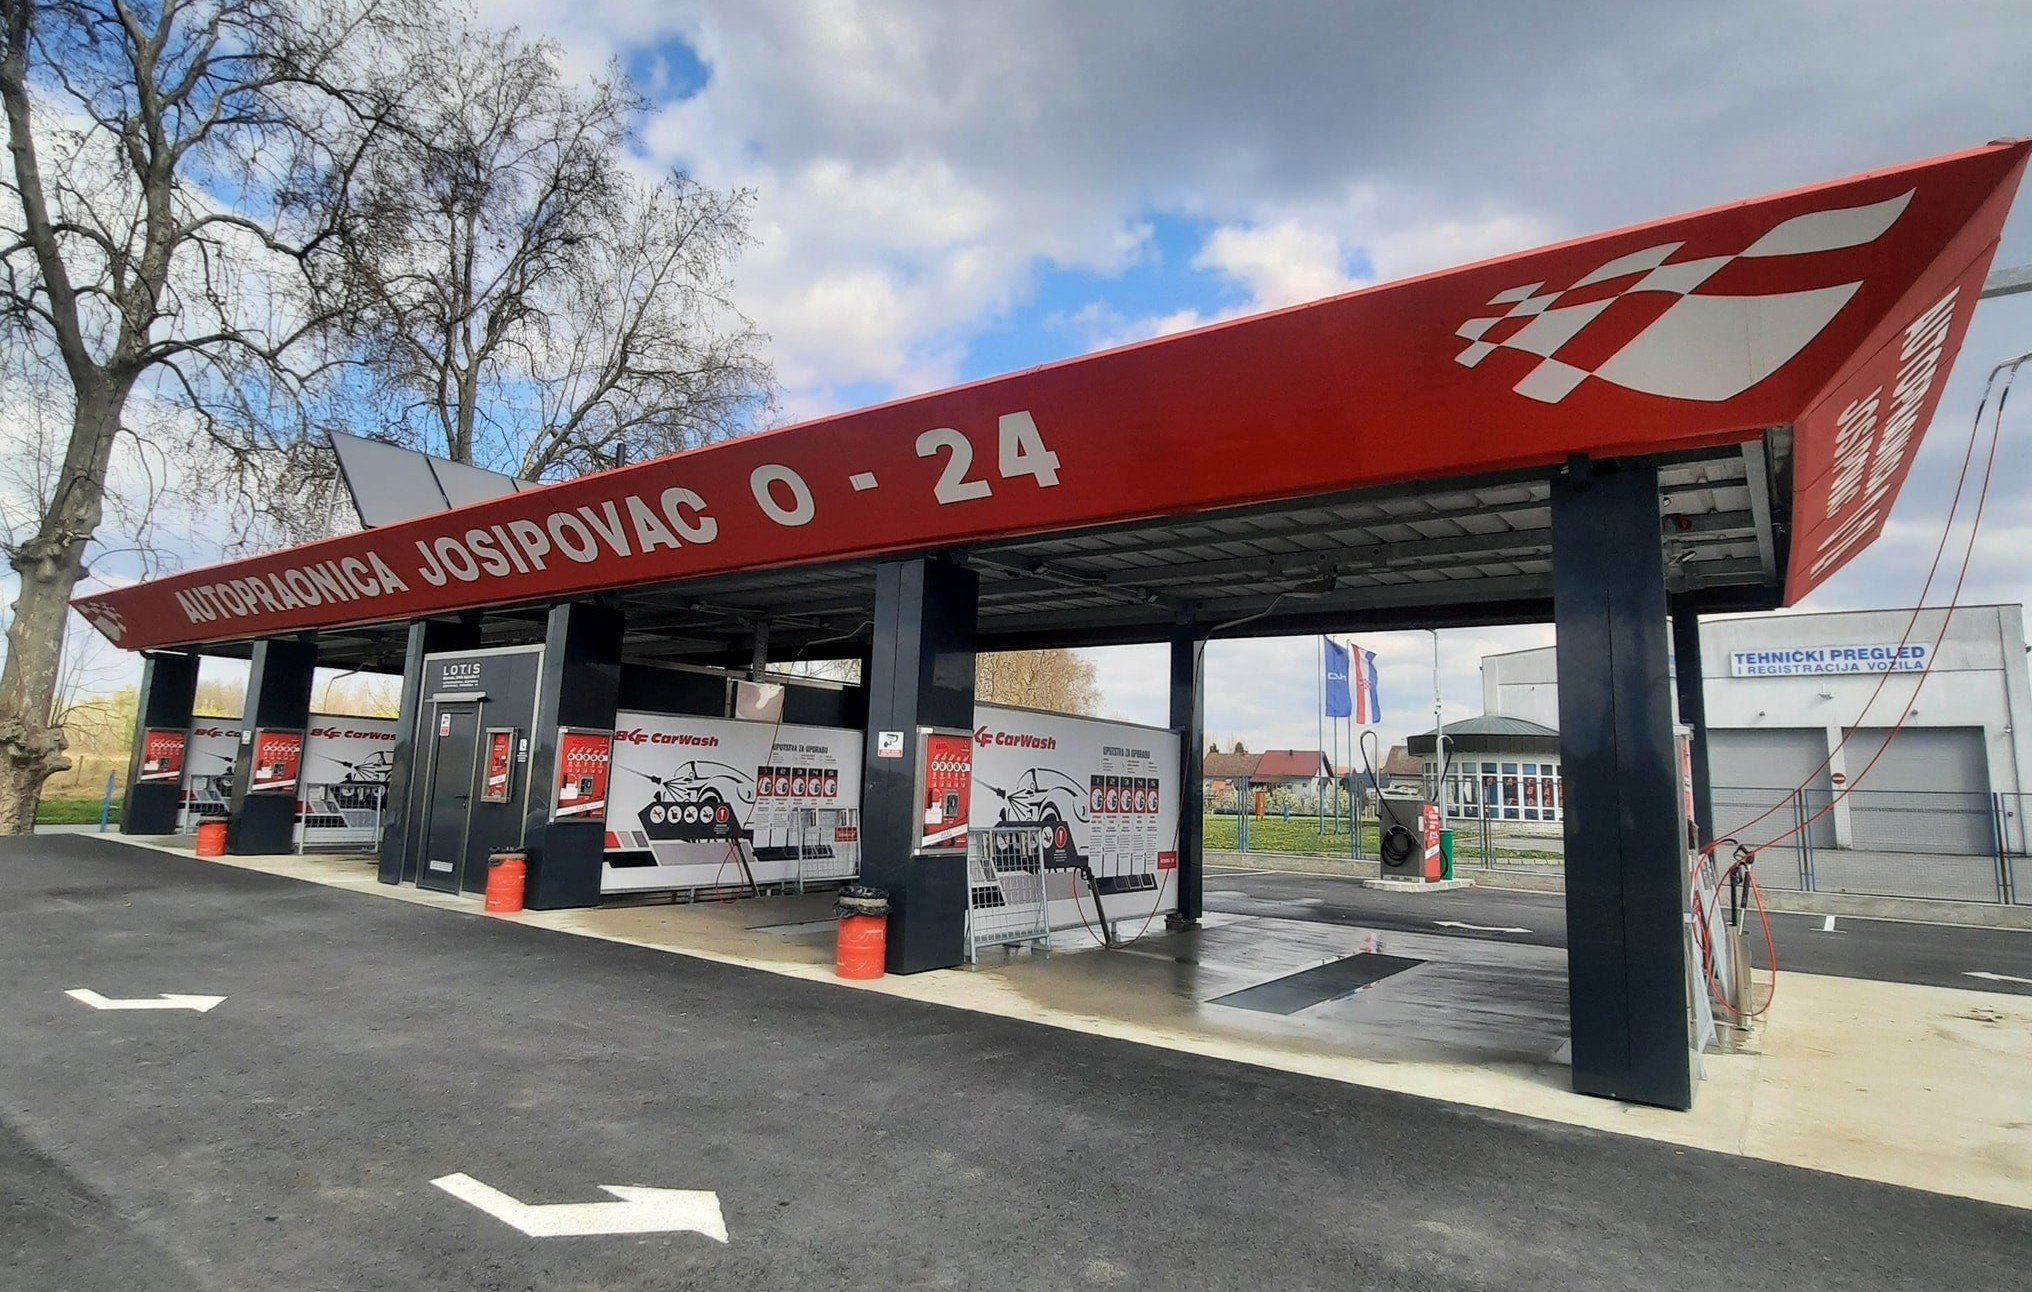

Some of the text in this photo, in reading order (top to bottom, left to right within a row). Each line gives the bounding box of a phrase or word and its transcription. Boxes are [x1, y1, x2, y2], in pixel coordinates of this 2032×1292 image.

[1860, 285, 1961, 501] AUTOPRAONICA
[174, 551, 411, 625] AUTOPRAONICA
[414, 486, 719, 587] JOSIPOVAC
[915, 410, 1062, 505] 24
[1830, 646, 1926, 661] PREGLED
[443, 662, 481, 676] LOTIS
[1737, 659, 1924, 675] I REGISTRACIJA VOZILA
[344, 730, 397, 741] CarWas
[651, 732, 720, 748] CarWash
[995, 731, 1057, 750] CarWash
